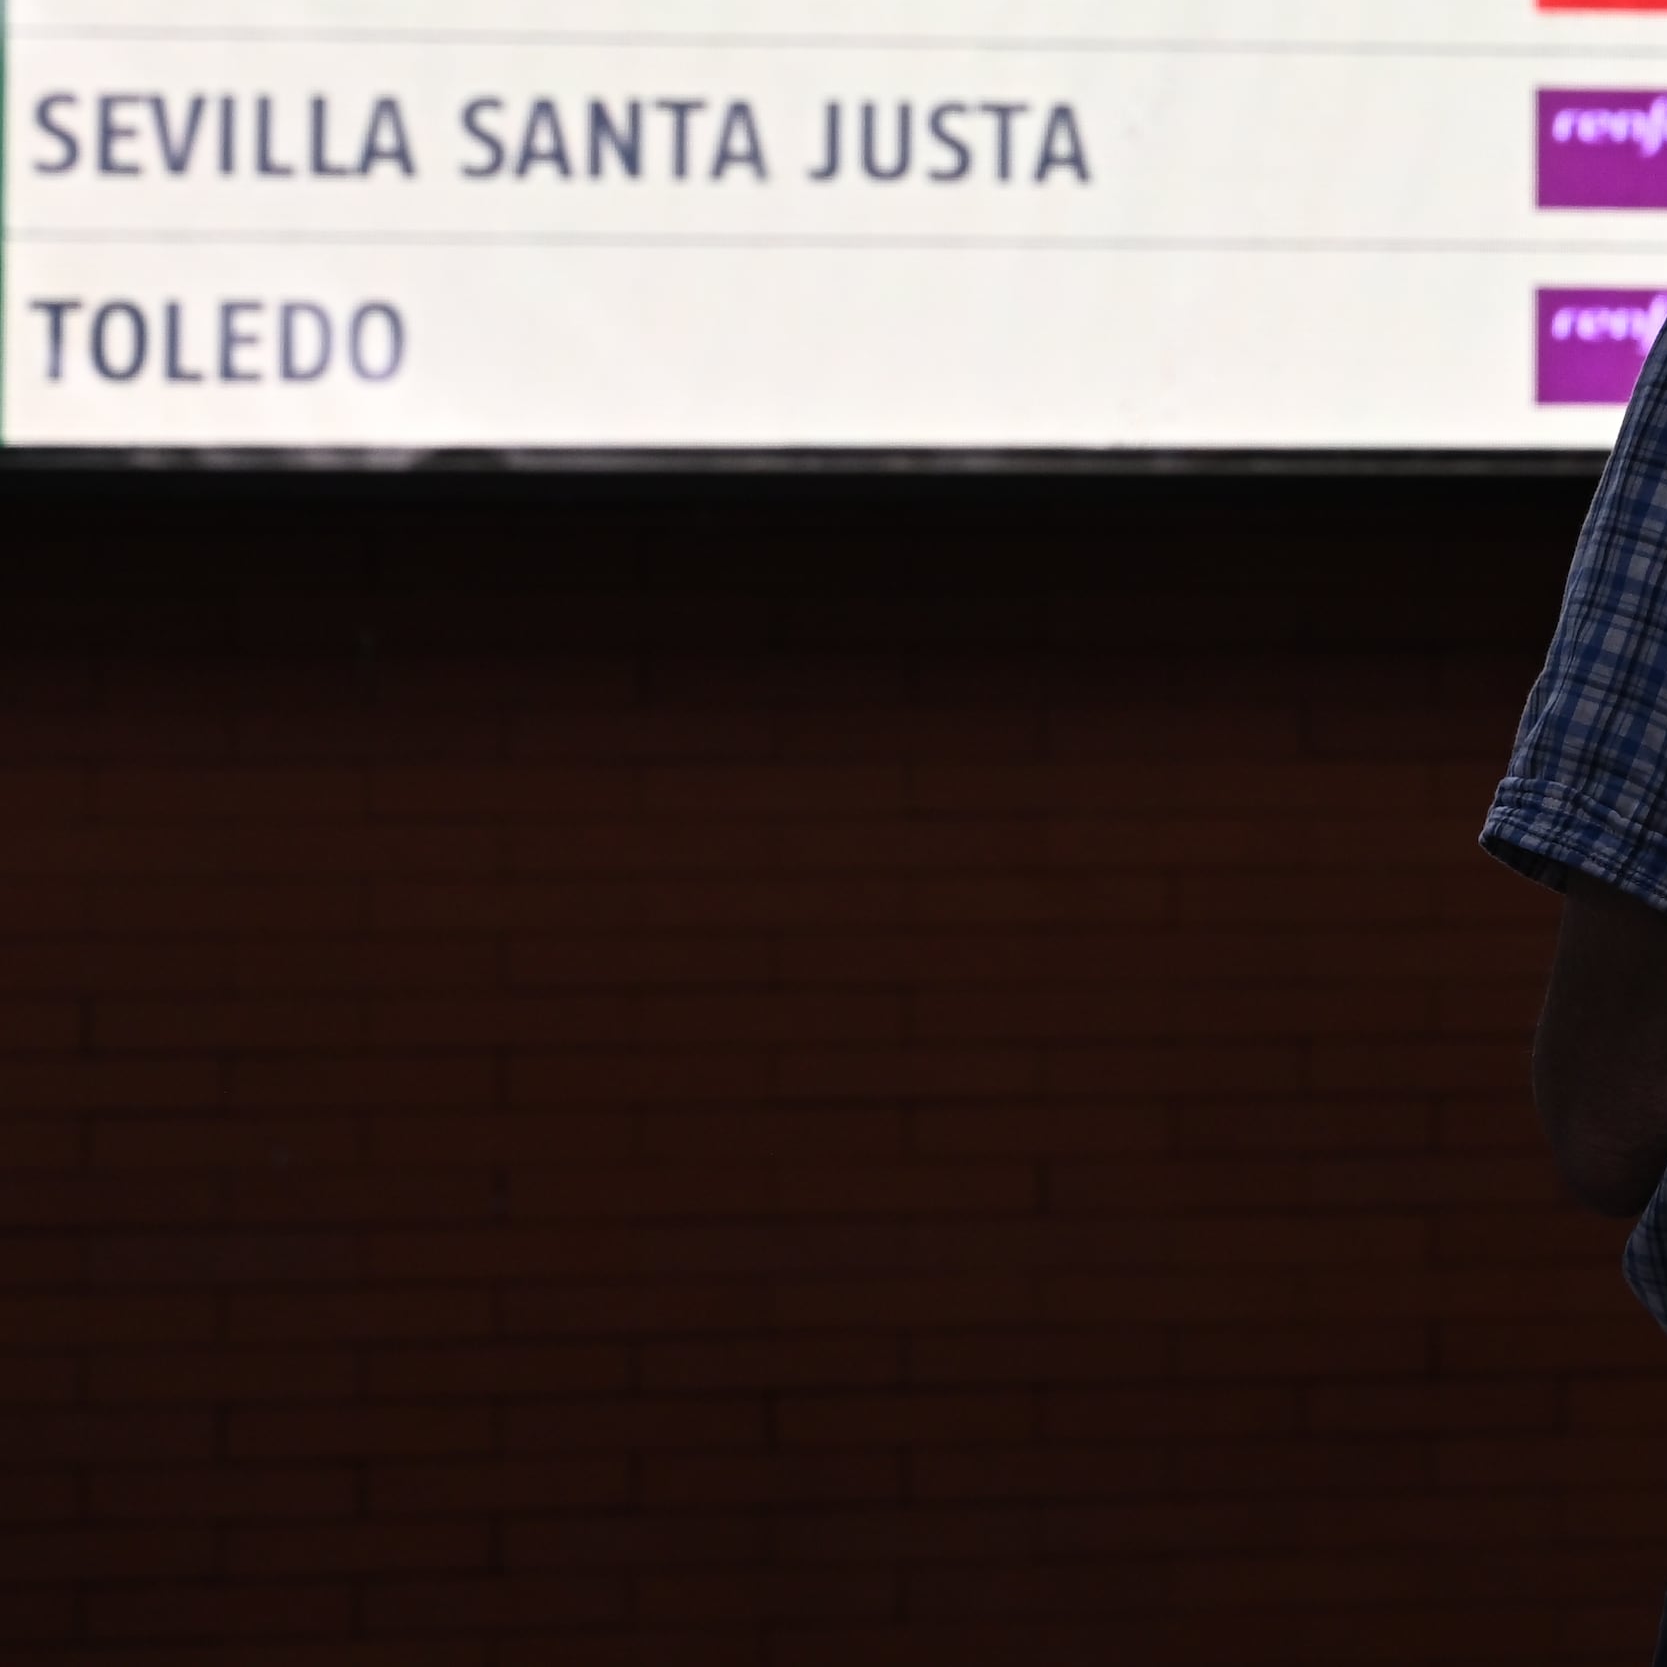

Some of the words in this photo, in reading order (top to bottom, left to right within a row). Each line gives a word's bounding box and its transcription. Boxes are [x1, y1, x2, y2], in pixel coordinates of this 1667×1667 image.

[32, 90, 418, 181] SEVILLA
[459, 95, 770, 182] SANTA
[808, 99, 1093, 186] JUSTA
[28, 296, 407, 386] TOLEDO
